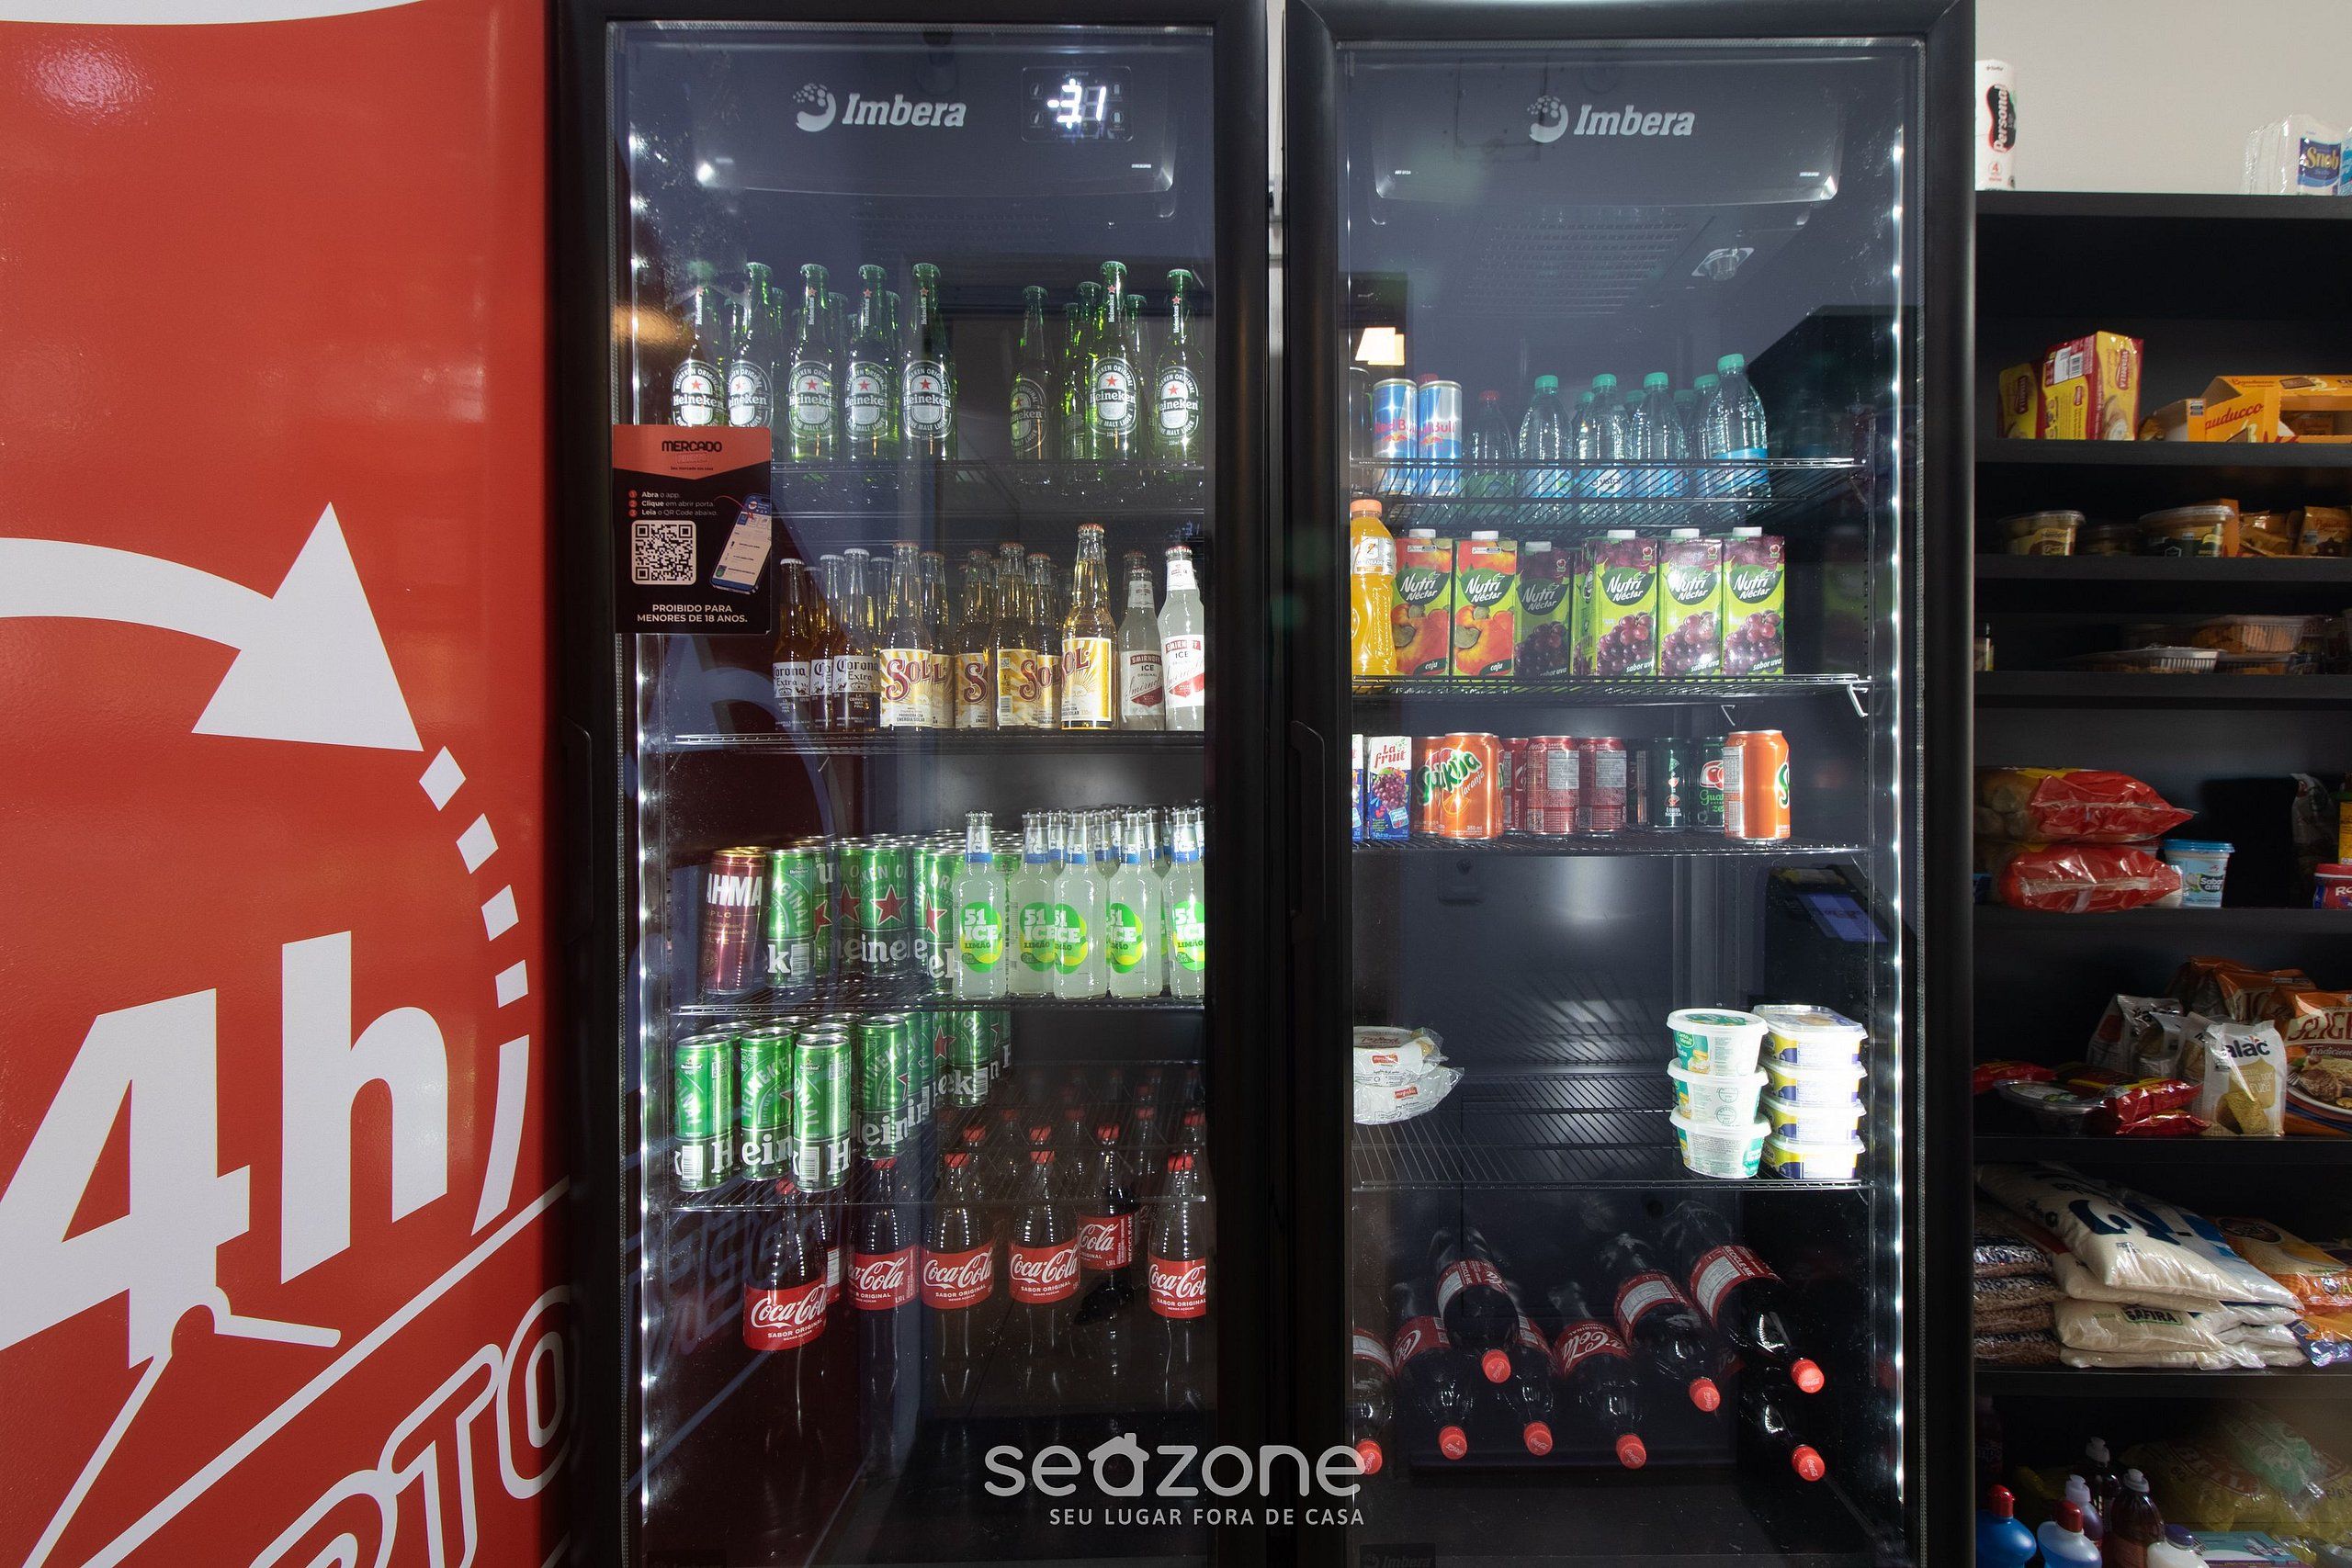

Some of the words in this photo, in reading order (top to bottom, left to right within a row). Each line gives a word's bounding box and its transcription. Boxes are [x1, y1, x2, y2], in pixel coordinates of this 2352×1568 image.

[842, 93, 967, 128] Imbera
[1574, 104, 1696, 137] Imbera
[1993, 84, 2007, 152] Personal
[2305, 147, 2339, 169] Snob
[926, 368, 947, 389] ORIGINAL
[1114, 365, 1134, 387] ORIGINAL
[673, 394, 725, 408] Heineken
[903, 393, 952, 408] Heineken
[1090, 391, 1136, 403] Heineken
[918, 423, 933, 431] MALT
[1104, 419, 1118, 428] MALT
[1119, 412, 1132, 427] LAGER
[1166, 426, 1181, 436] MALT
[662, 440, 723, 453] MERCADO
[641, 501, 664, 509] Clique
[1401, 572, 1436, 593] Nutri
[1464, 572, 1501, 593] Nutri
[1607, 573, 1642, 593] Nutri
[1734, 571, 1770, 592] Nutri
[1406, 590, 1438, 602] Néctar
[1471, 591, 1503, 604] Néctar
[1521, 586, 1555, 604] Nutri
[1612, 589, 1644, 602] Néctar
[1678, 588, 1709, 601] Néctar
[1739, 586, 1770, 600] Néctar
[651, 604, 703, 614] PROIBIDO
[705, 604, 733, 614] PARA
[637, 614, 687, 623] MENORES
[688, 615, 702, 623] DE
[705, 615, 715, 623] 18
[717, 614, 749, 624] ANOS.
[1425, 661, 1439, 671] caju
[1489, 661, 1504, 671] caju
[1626, 663, 1644, 674] sabor
[1707, 660, 1720, 669] uva
[1752, 662, 1770, 671] sabor
[1770, 659, 1782, 667] uva
[848, 671, 873, 682] Extra
[1383, 745, 1396, 754] La
[1374, 750, 1406, 768] fruit
[1460, 771, 1486, 797] laranja
[965, 908, 987, 925] 51
[1024, 908, 1046, 926] 51
[1175, 908, 1197, 926] 51
[964, 924, 998, 942] ICE
[1023, 925, 1054, 942] ICE
[965, 941, 991, 949] LIMÃO
[1023, 941, 1050, 949] LIMÃO
[1178, 940, 1204, 948] LIMÃO
[923, 1245, 993, 1290] Coca-Cola
[1011, 1243, 1079, 1284] Coca-Cola
[1724, 1245, 1757, 1278] RECICLE-ME
[956, 1284, 986, 1298] ORIGINAL
[1042, 1280, 1071, 1292] ORIGINAL
[1156, 1298, 1175, 1306] SABOR
[2126, 1308, 2178, 1325] SAFIRA
[767, 1330, 794, 1339] SABOR
[795, 1317, 823, 1336] ORIGINAL
